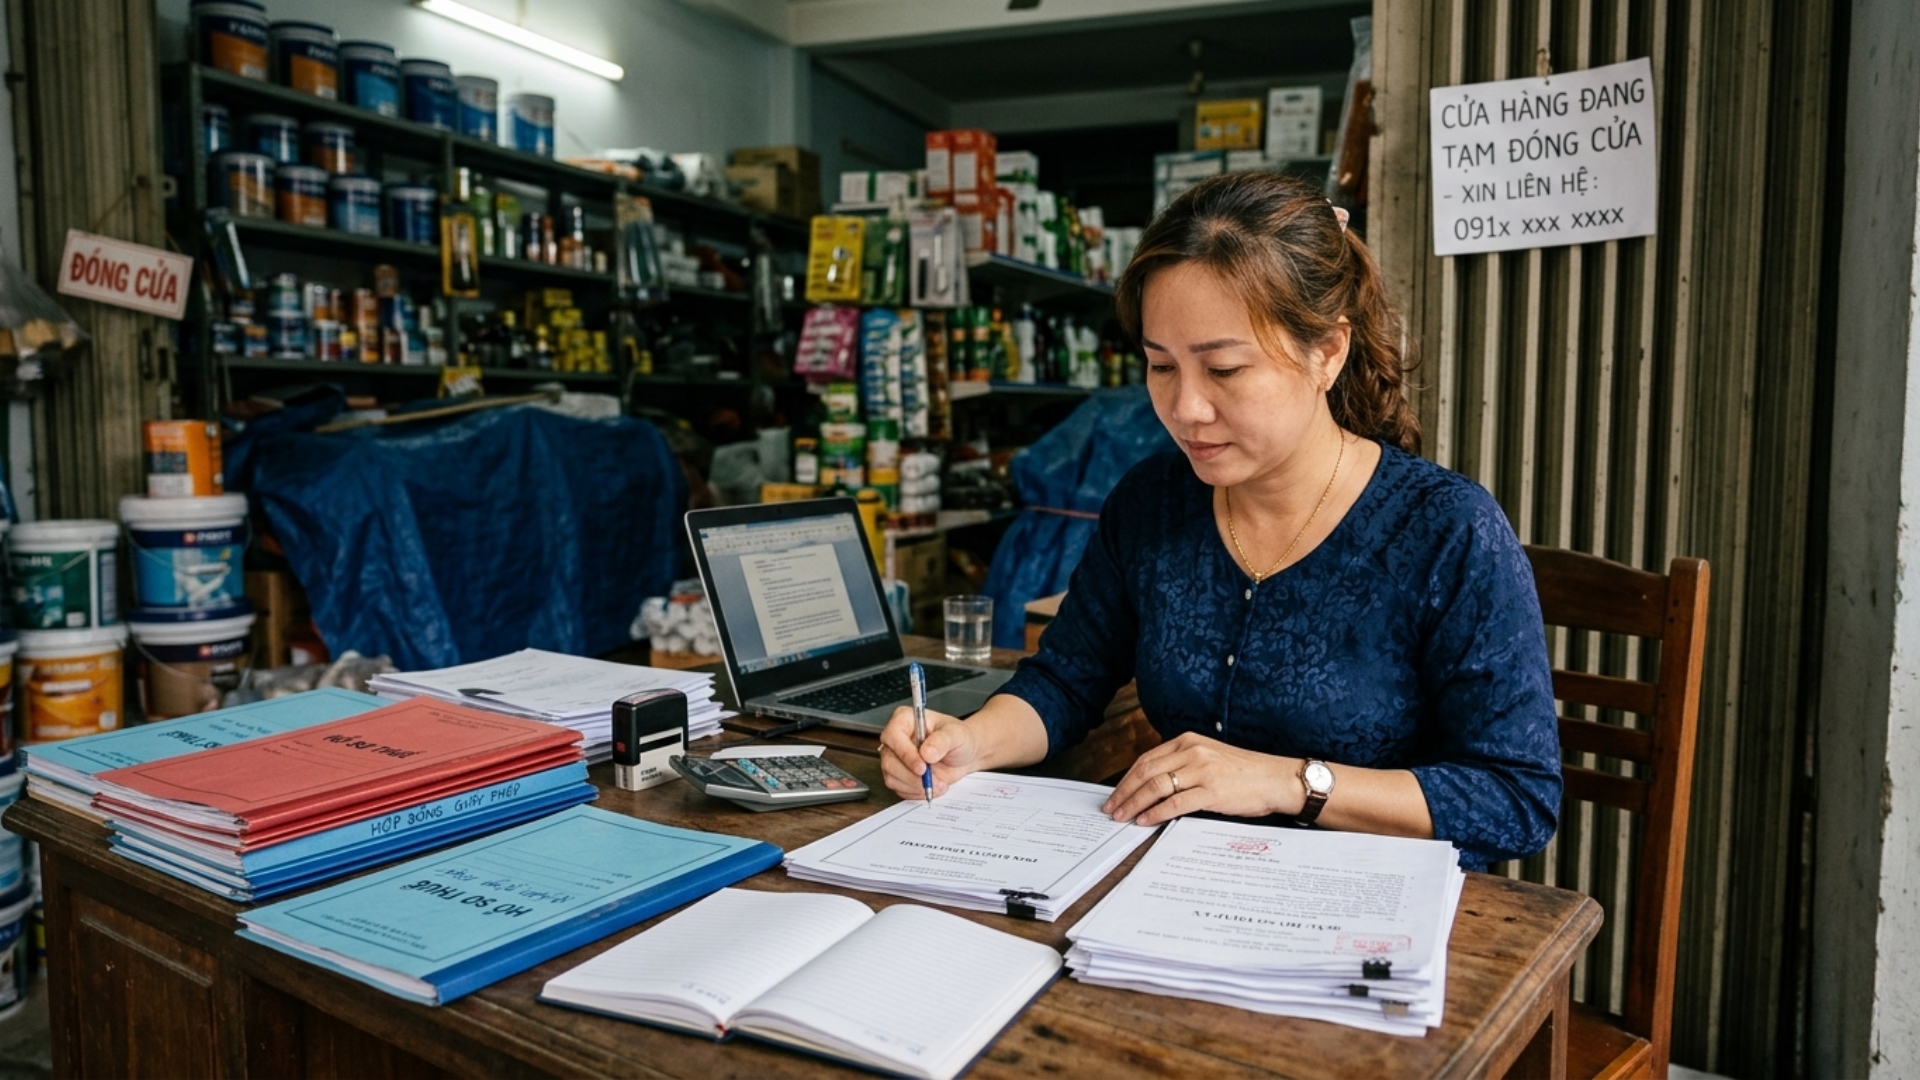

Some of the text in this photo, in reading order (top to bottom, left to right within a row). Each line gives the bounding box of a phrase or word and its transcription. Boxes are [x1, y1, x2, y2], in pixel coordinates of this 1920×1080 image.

[1441, 78, 1645, 129] CỬA HÀNG ĐANG
[1442, 115, 1642, 173] TẠM ĐÓNG CỬA
[1462, 183, 1496, 204] XIN
[1506, 172, 1550, 200] LIÊN
[1454, 215, 1510, 241] 091x
[70, 247, 178, 304] ĐÓNG CỬA
